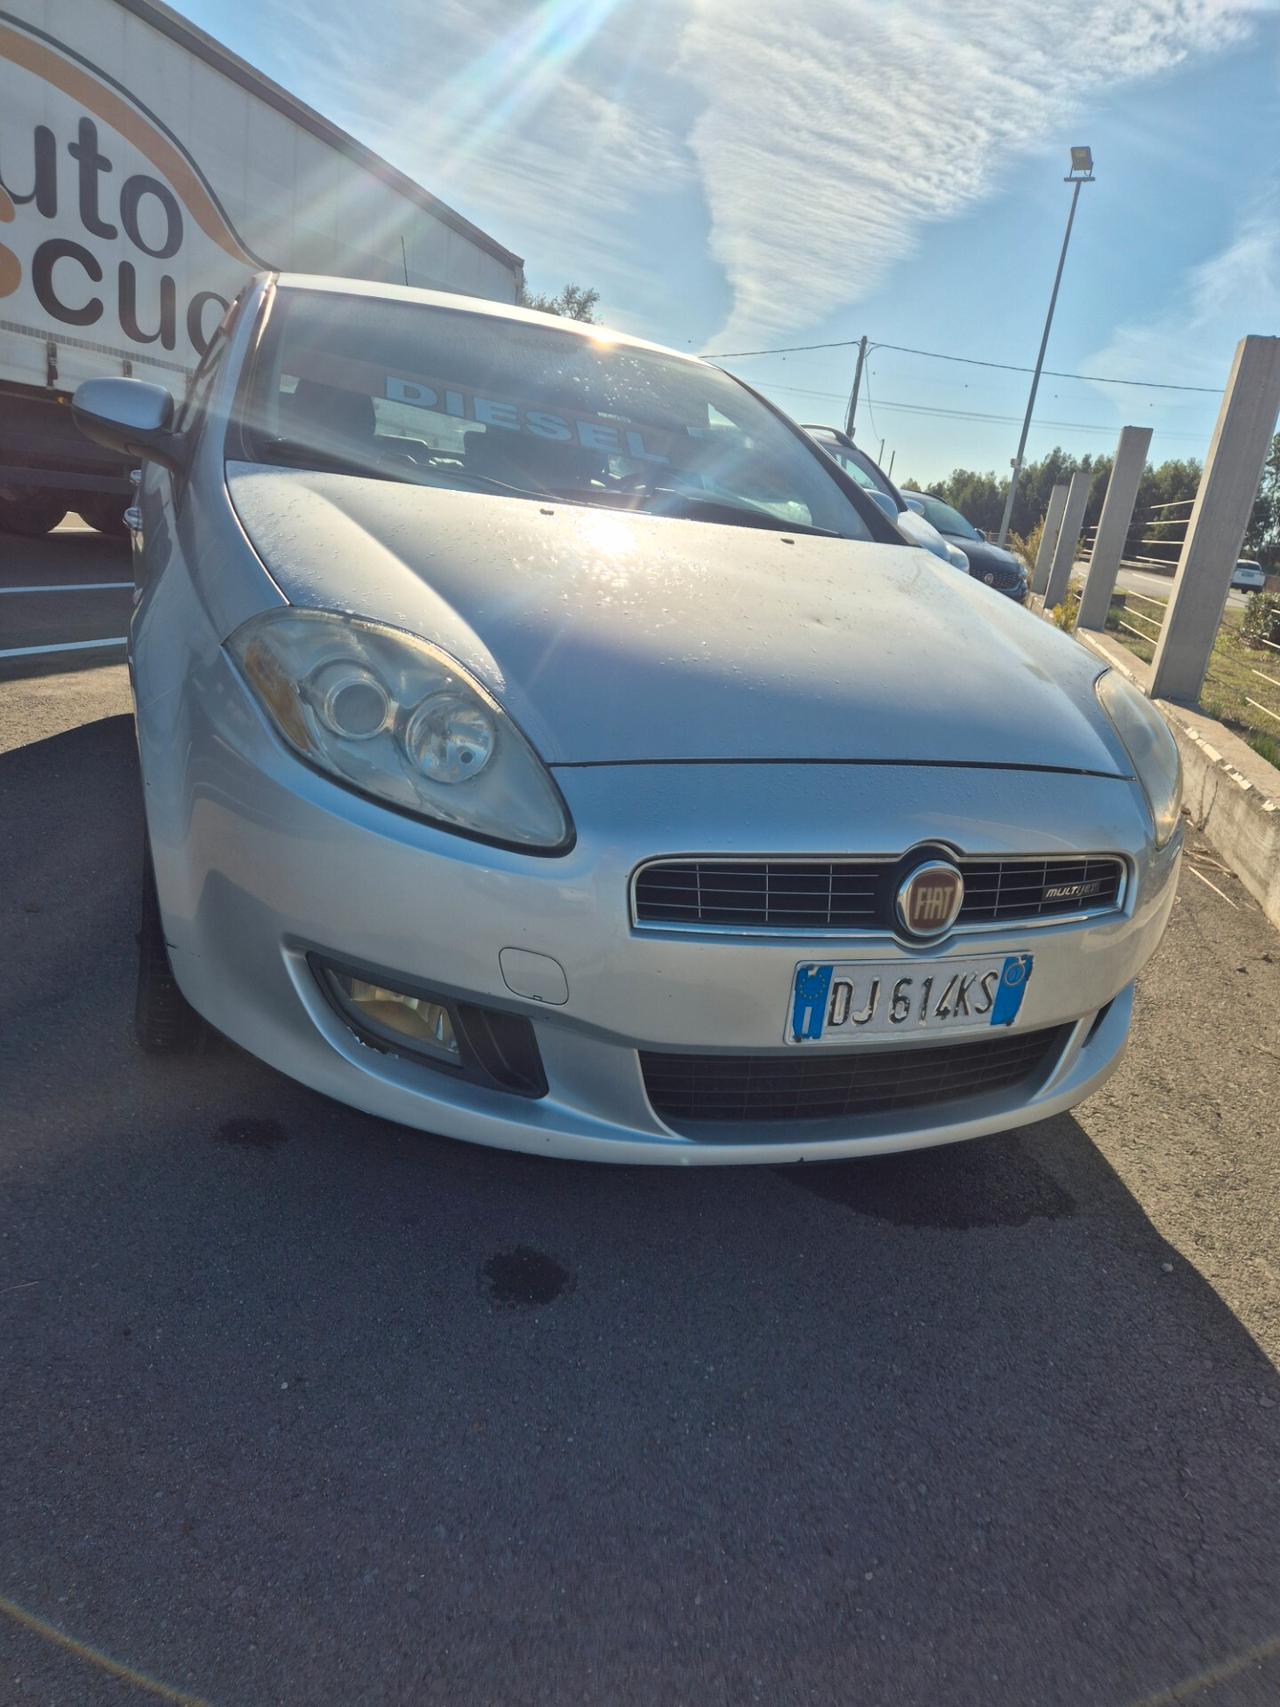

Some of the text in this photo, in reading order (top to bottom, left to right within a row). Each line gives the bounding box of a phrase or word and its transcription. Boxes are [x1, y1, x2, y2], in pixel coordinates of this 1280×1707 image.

[0, 185, 230, 357] cuo
[385, 376, 670, 465] DIESEL
[913, 886, 955, 920] FIAT
[826, 968, 999, 1027] DJ 614KS
